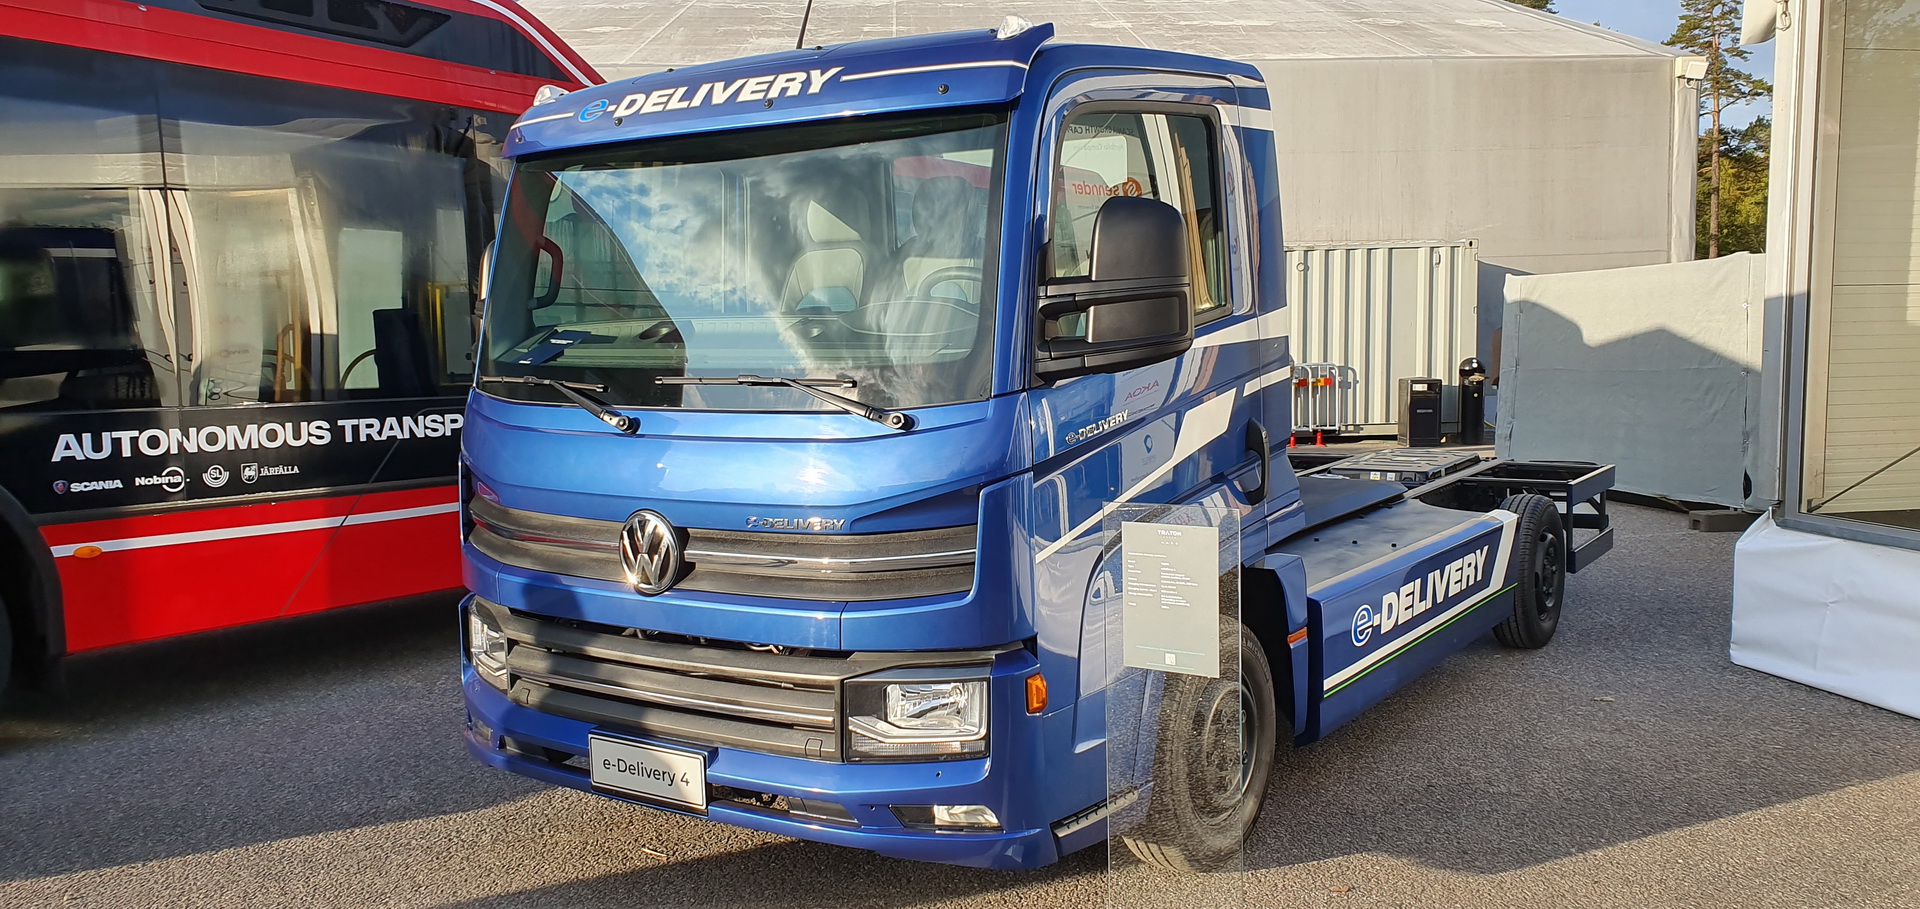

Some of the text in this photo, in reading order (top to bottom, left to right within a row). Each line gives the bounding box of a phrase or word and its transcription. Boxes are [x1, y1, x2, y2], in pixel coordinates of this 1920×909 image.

[578, 66, 845, 123] e-DELIVERY
[51, 413, 464, 463] AUTONOMOUS TRANSP
[134, 473, 183, 486] Nobina
[210, 468, 223, 479] SL
[259, 464, 300, 477] JÄRFÄLLA
[69, 479, 124, 493] SCANIA
[1351, 544, 1490, 648] e-DELIVERY
[602, 757, 691, 788] e-Delivery 4
